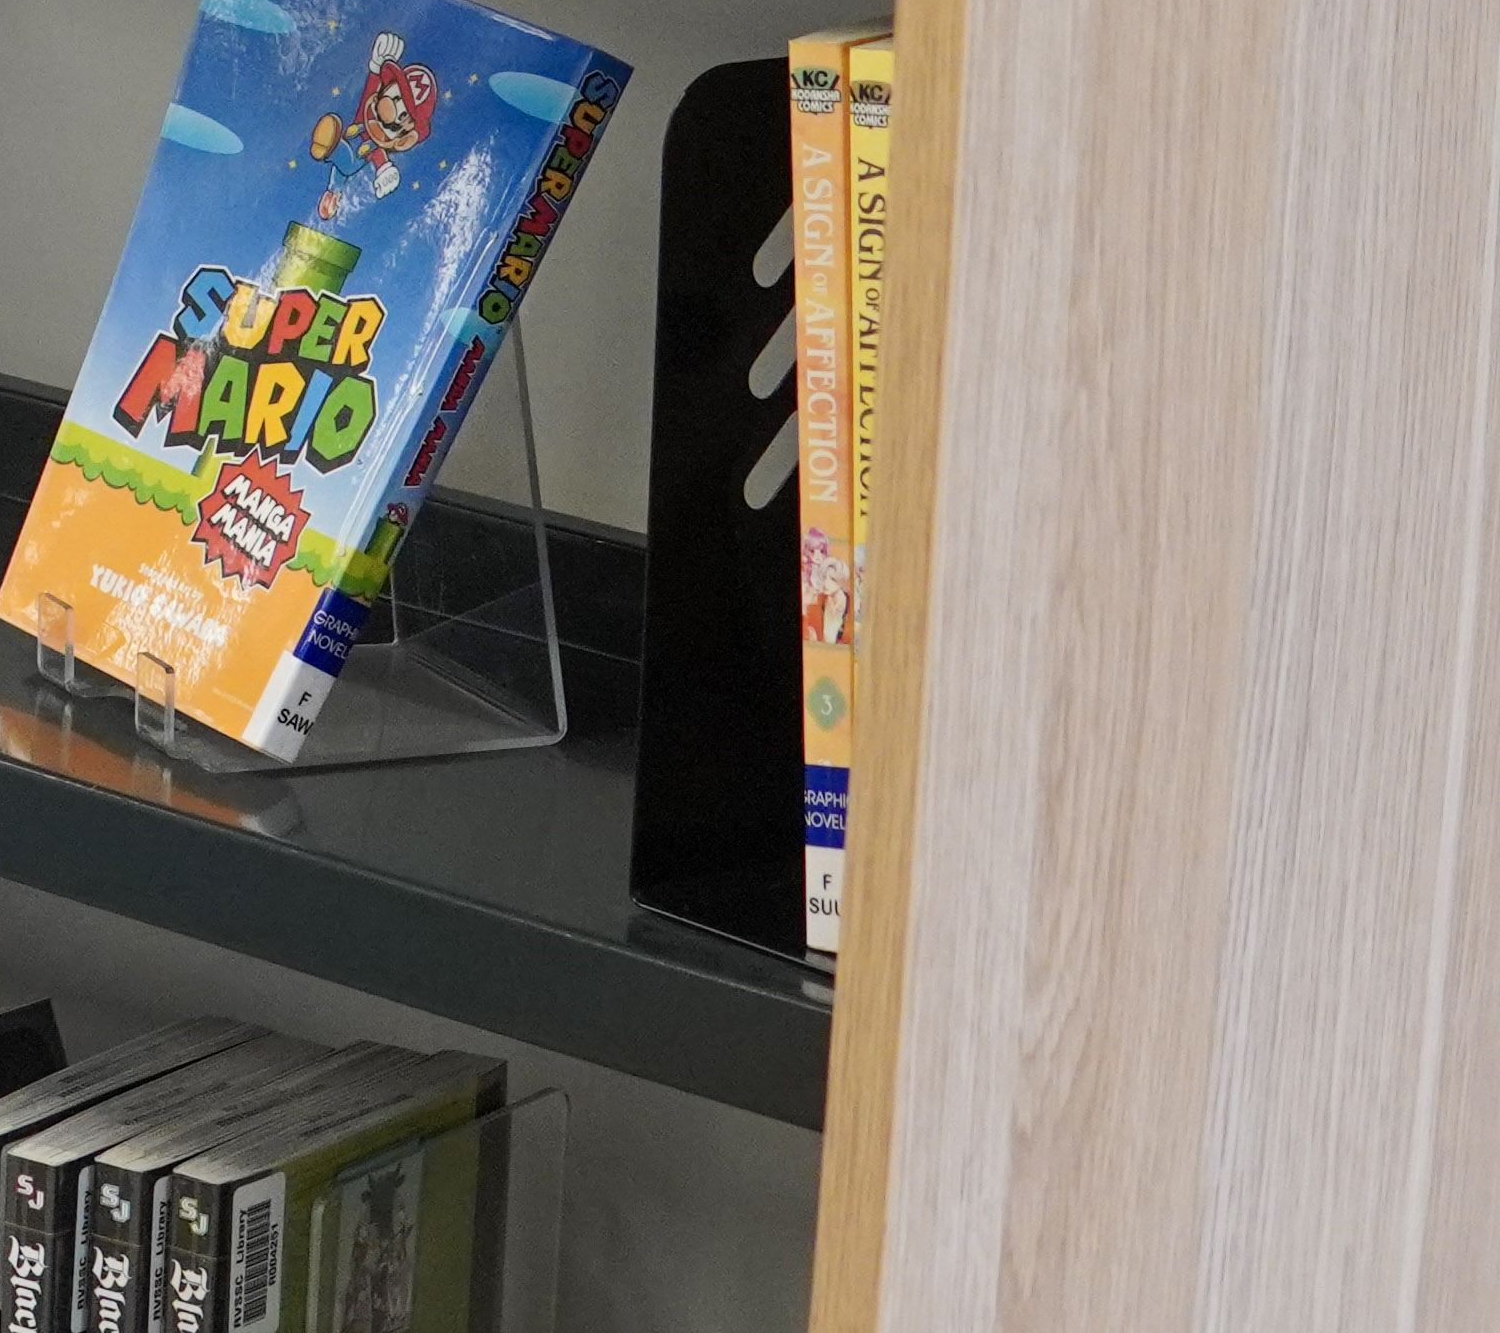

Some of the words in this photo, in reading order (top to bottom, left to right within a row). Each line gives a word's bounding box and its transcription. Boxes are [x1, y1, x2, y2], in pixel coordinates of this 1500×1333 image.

[536, 69, 621, 202] SUPER
[802, 142, 833, 167] A
[477, 193, 559, 326] MARIO
[803, 177, 834, 268] SIGN
[174, 264, 387, 371] SUPER
[812, 271, 828, 296] OF
[111, 332, 379, 477] MARIO
[806, 300, 839, 504] AFFECTION
[210, 502, 279, 569] MANIA
[223, 473, 296, 543] MANGA
[90, 564, 151, 607] YUKIO
[277, 707, 314, 736] SAW
